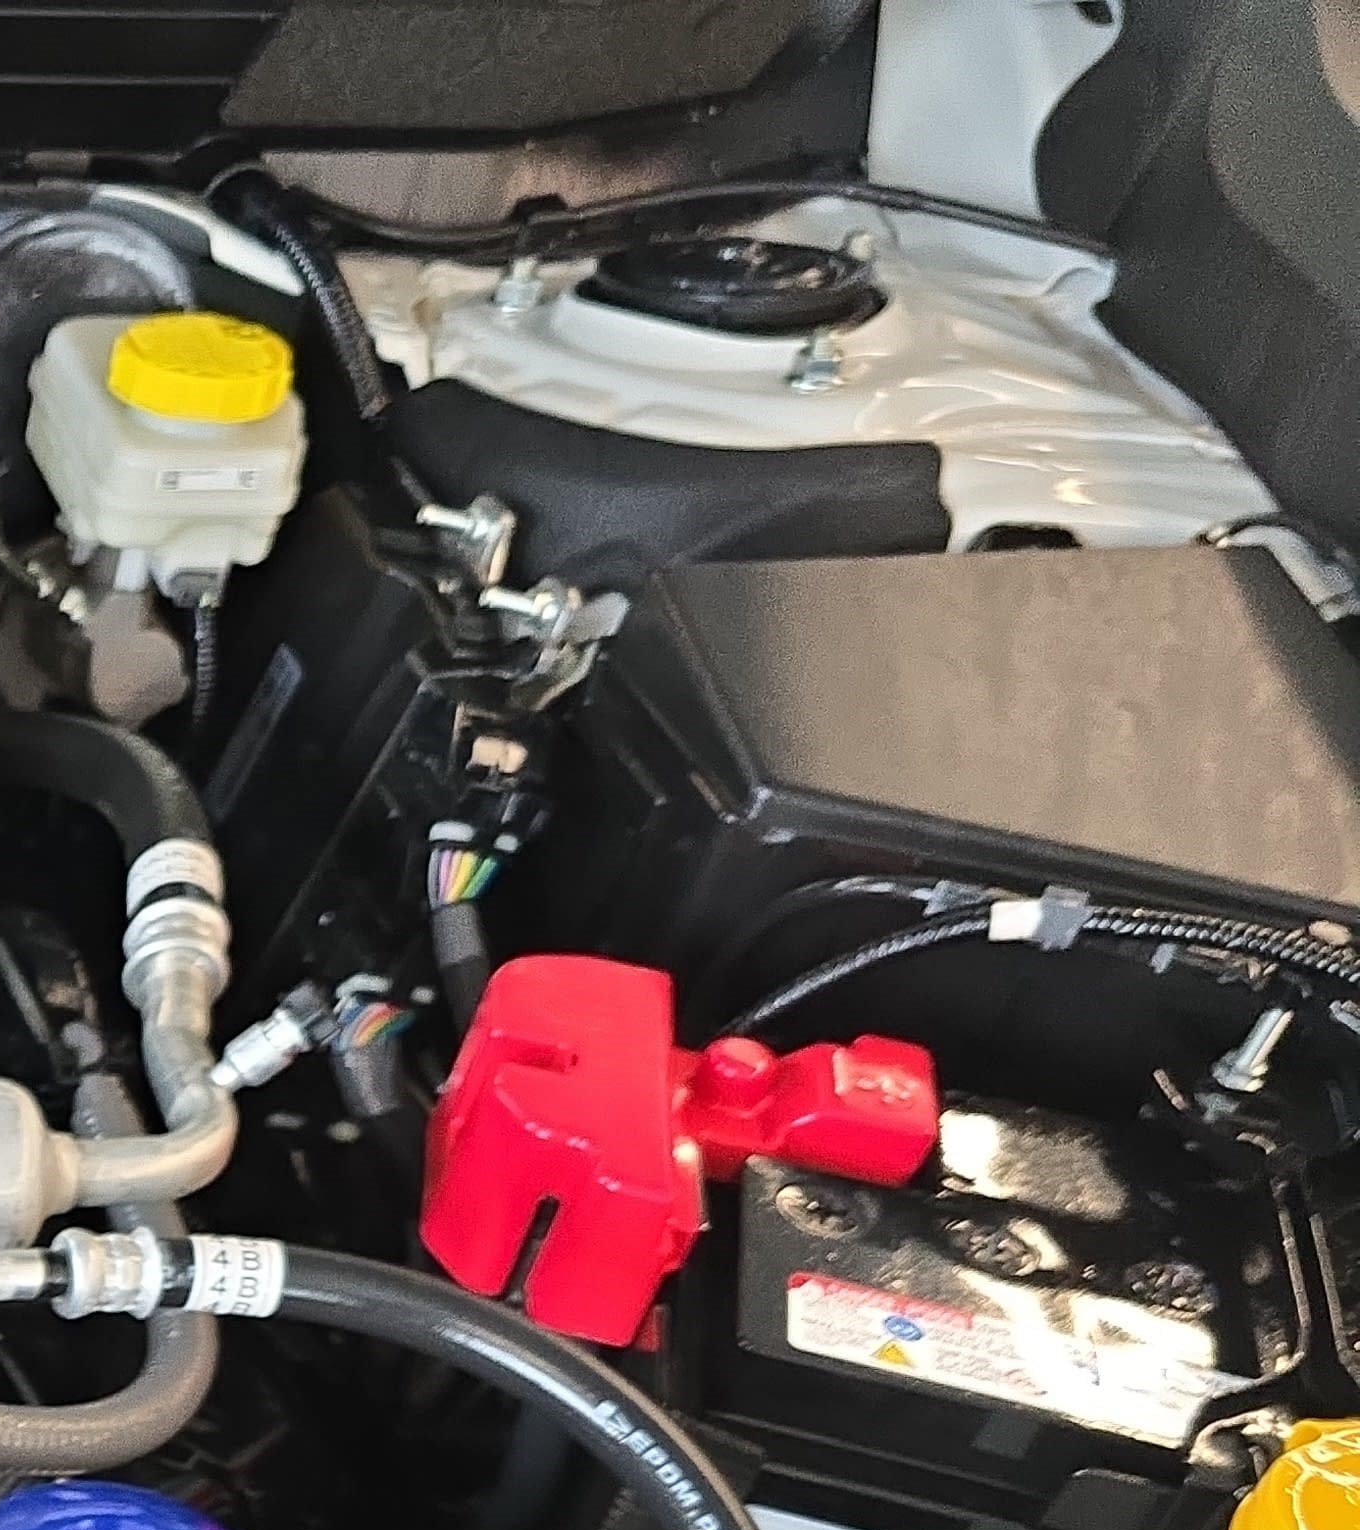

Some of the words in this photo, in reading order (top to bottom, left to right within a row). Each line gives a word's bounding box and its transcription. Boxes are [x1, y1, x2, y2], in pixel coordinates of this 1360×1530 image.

[211, 1248, 230, 1270] 4
[241, 1250, 263, 1271] B
[208, 1276, 227, 1297] 4
[237, 1276, 258, 1298] B
